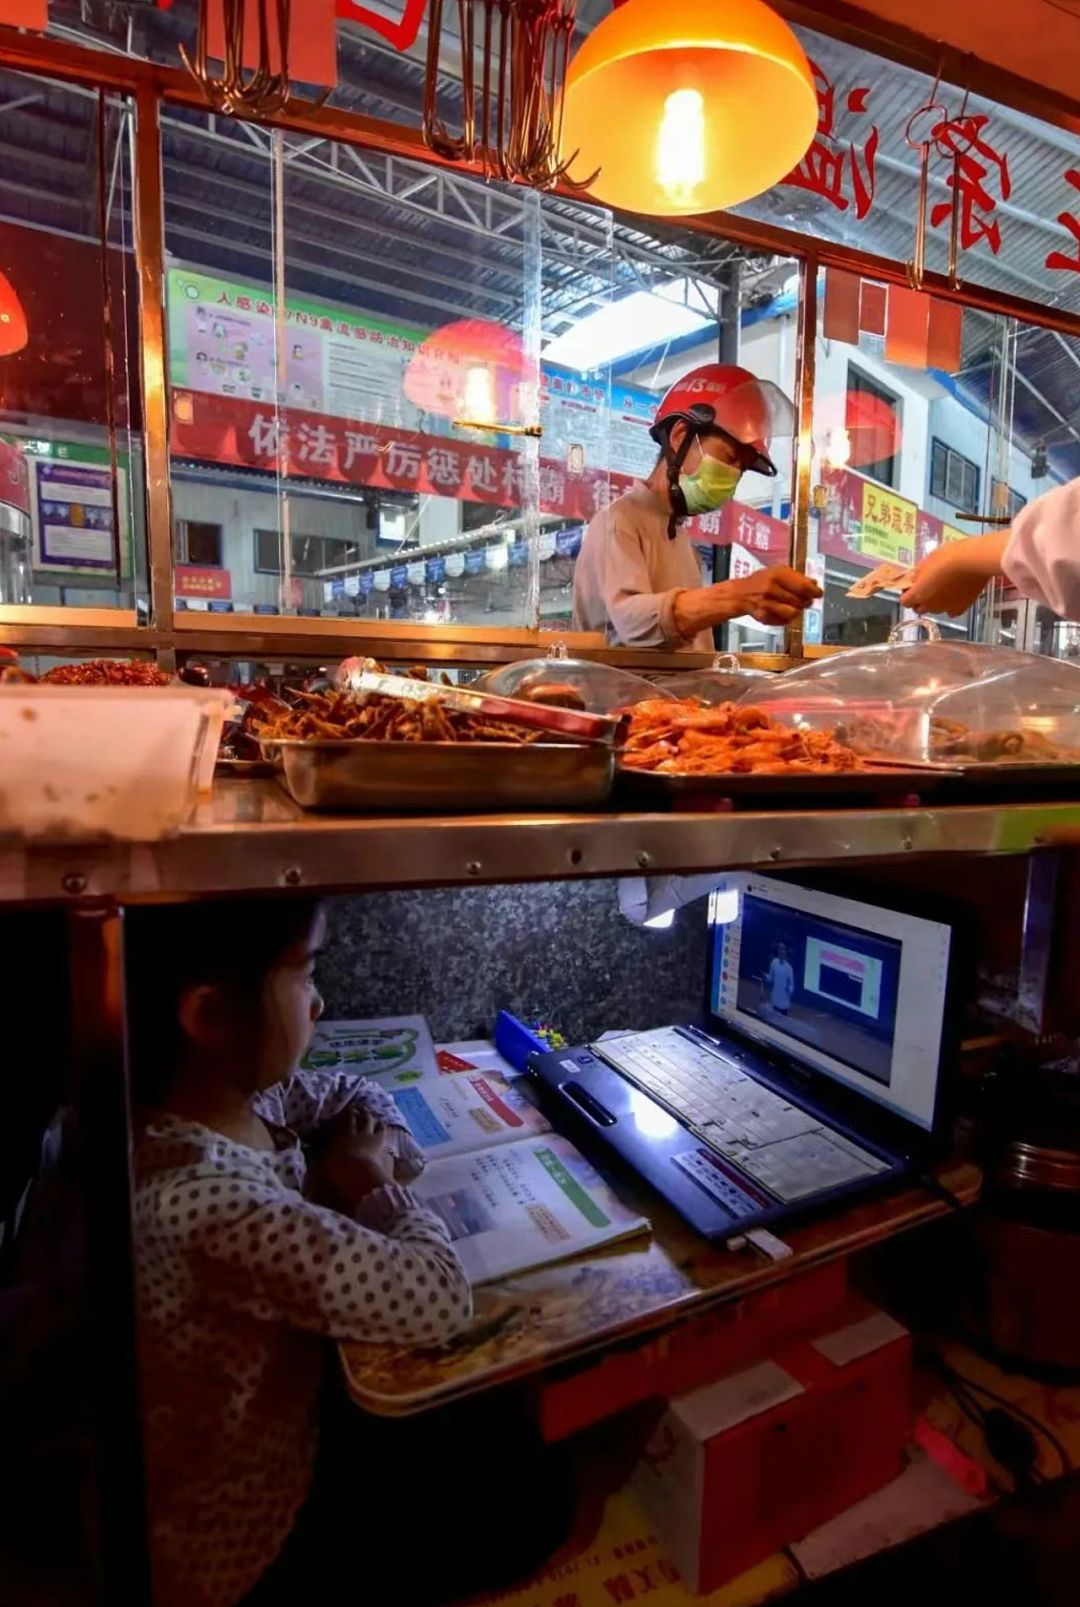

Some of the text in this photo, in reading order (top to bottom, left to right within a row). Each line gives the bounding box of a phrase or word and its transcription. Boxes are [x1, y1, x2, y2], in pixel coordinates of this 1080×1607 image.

[738, 513, 771, 551] 行霸
[865, 494, 915, 537] 兄弟蔬果
